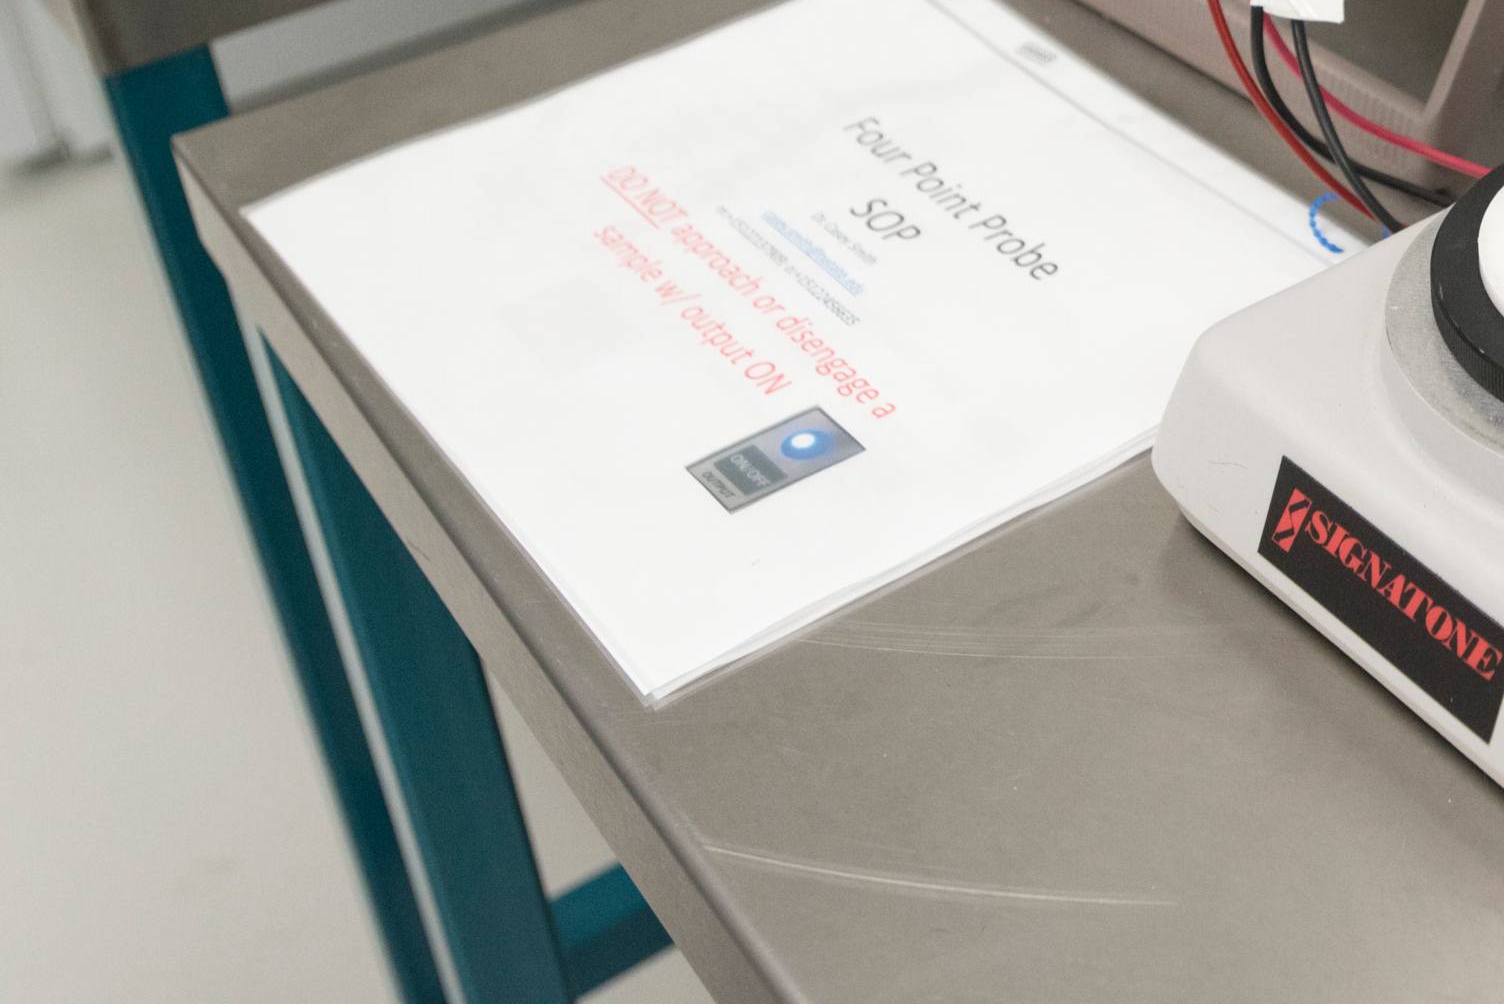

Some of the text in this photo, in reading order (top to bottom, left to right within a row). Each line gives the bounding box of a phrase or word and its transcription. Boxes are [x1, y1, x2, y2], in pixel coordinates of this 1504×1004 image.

[843, 117, 1059, 281] Four Point Probe
[850, 197, 921, 241] SOP
[593, 225, 663, 283] sample
[655, 280, 703, 306] w/
[680, 305, 753, 365] output
[744, 361, 792, 396] ON
[670, 224, 765, 297] approach
[752, 295, 786, 314] or
[775, 315, 880, 404] disengage
[871, 402, 896, 419] a
[1304, 509, 1504, 682] SIGNATONE
